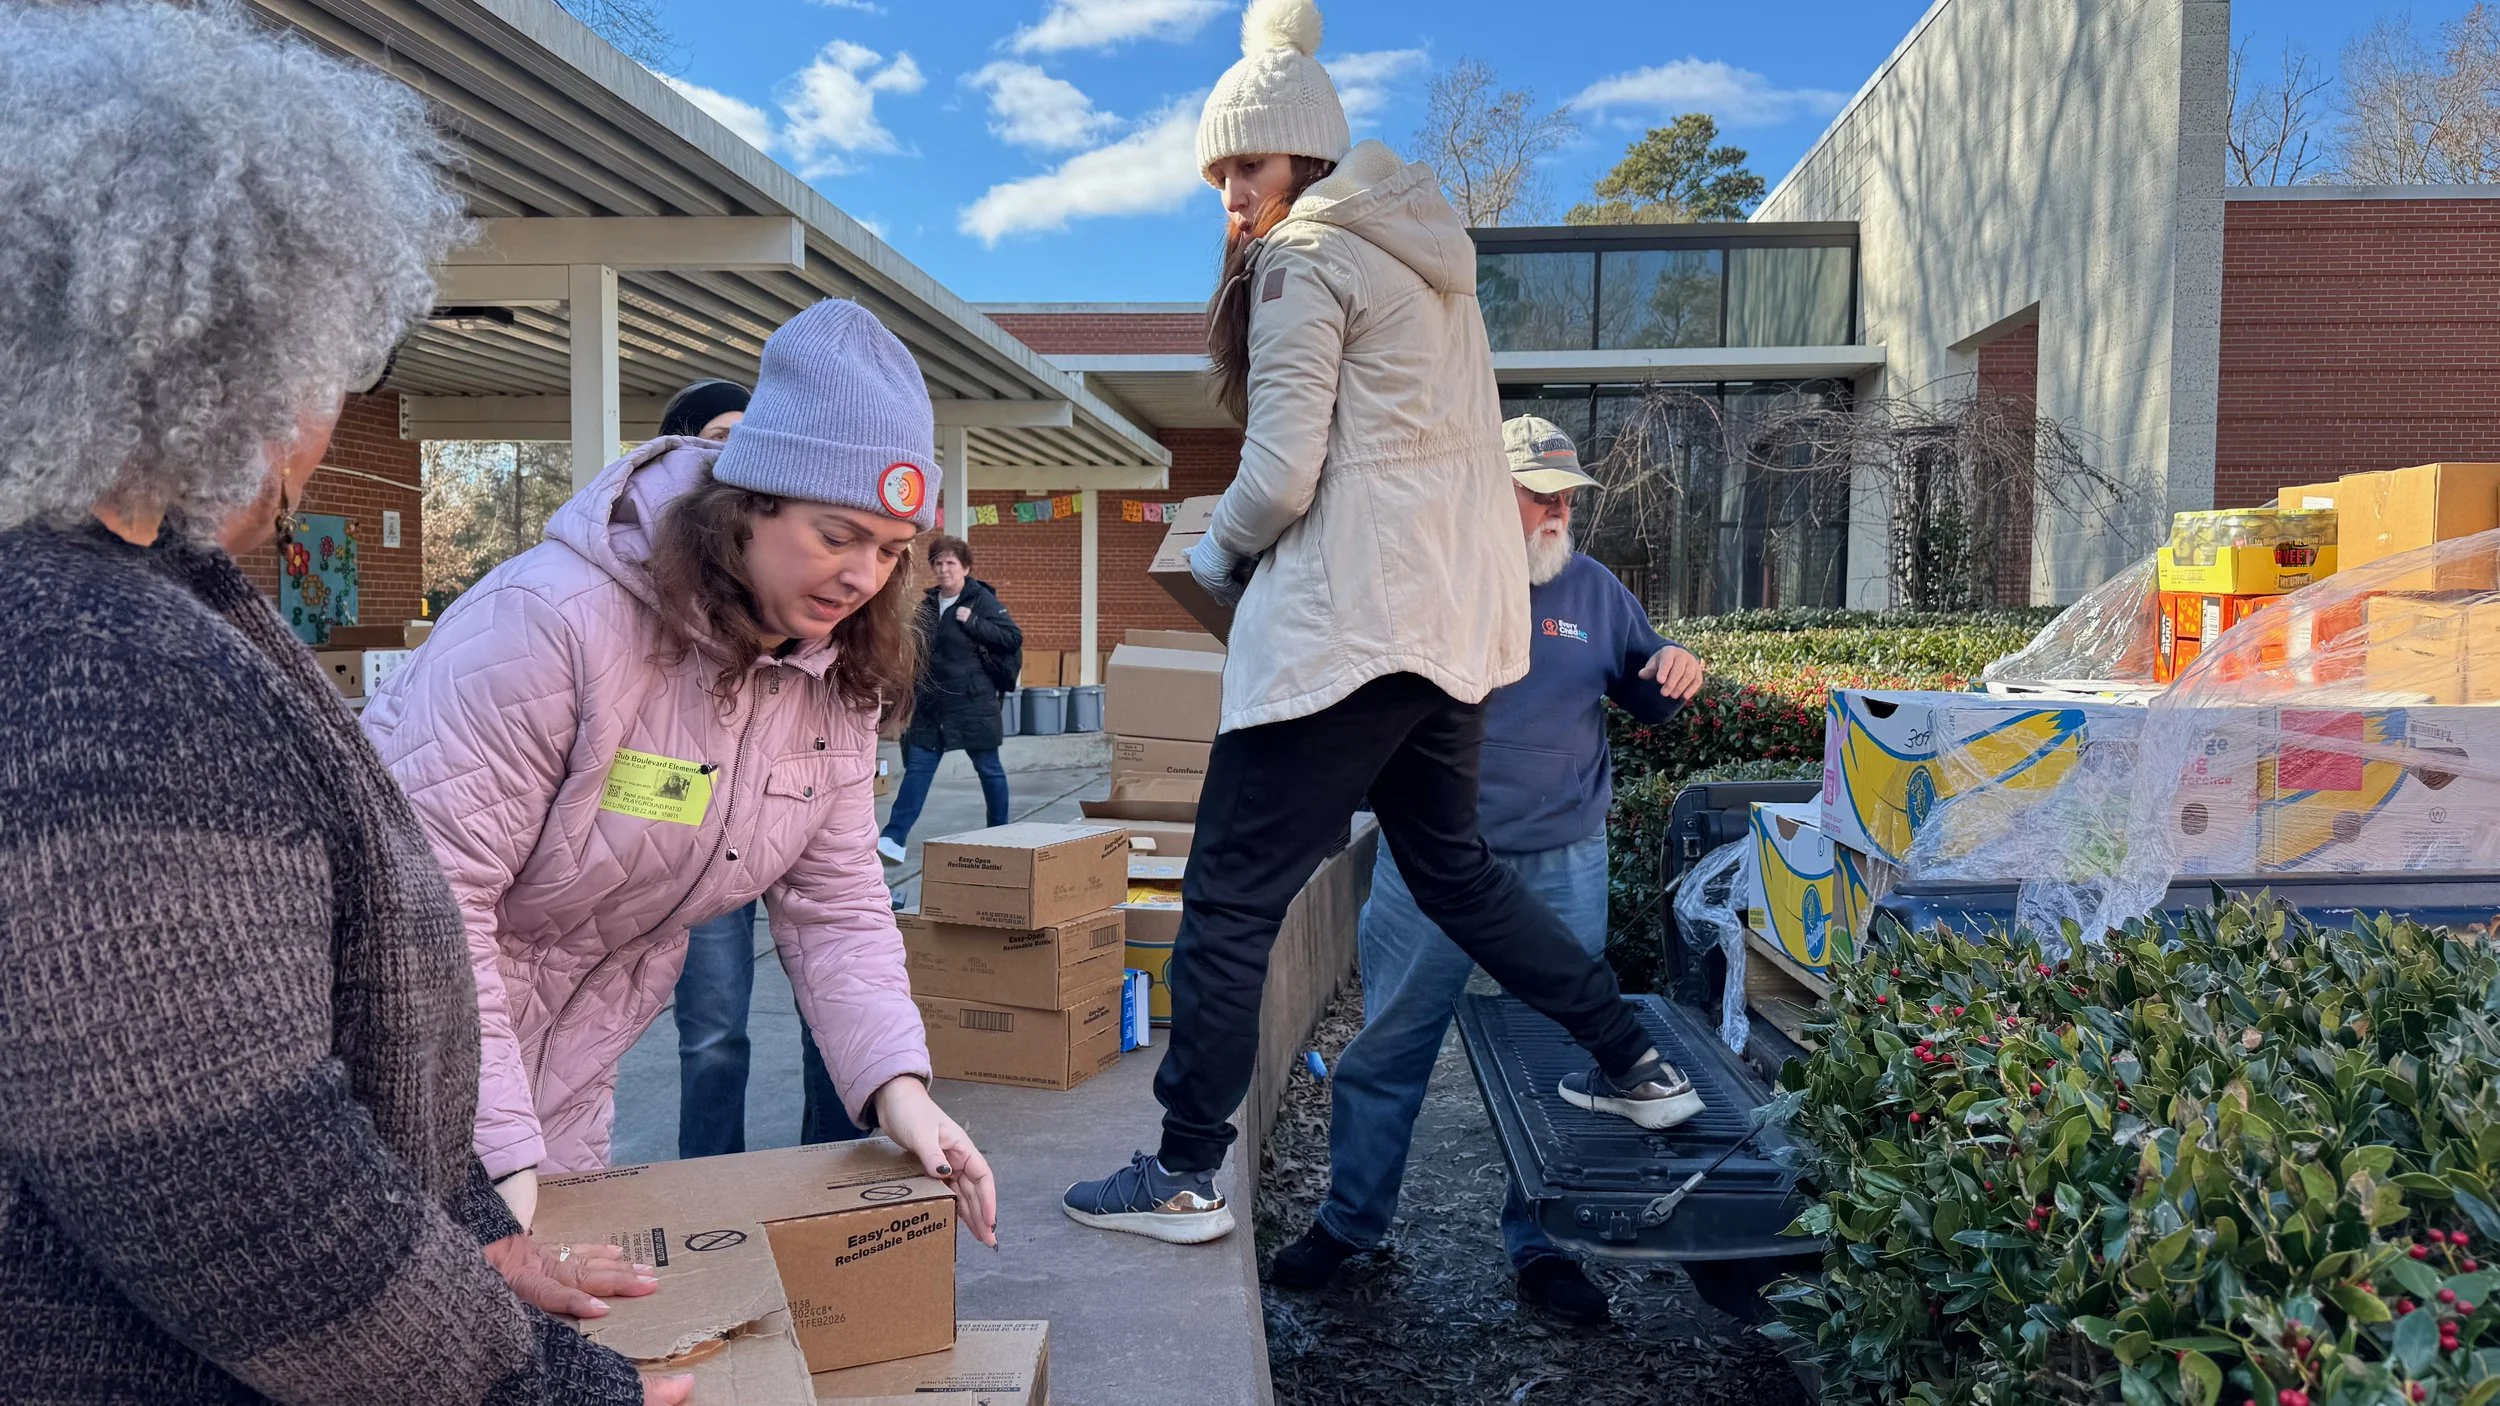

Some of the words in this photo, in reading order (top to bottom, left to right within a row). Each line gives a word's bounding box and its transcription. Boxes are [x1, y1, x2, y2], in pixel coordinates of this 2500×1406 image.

[614, 751, 630, 761] Club
[631, 755, 667, 768] Boulevard
[668, 762, 701, 774] Elementa
[947, 861, 981, 870] Reclosable
[981, 862, 1003, 871] Bottle!
[958, 855, 991, 865] Easy-Open
[1008, 932, 1046, 944] Easy-Open
[1003, 941, 1035, 951] Reclosable
[847, 1211, 930, 1249] Easy-Open
[835, 1235, 903, 1267] Reclosable
[906, 1218, 948, 1241] Bottle!
[800, 1313, 846, 1329] 1FEB2026
